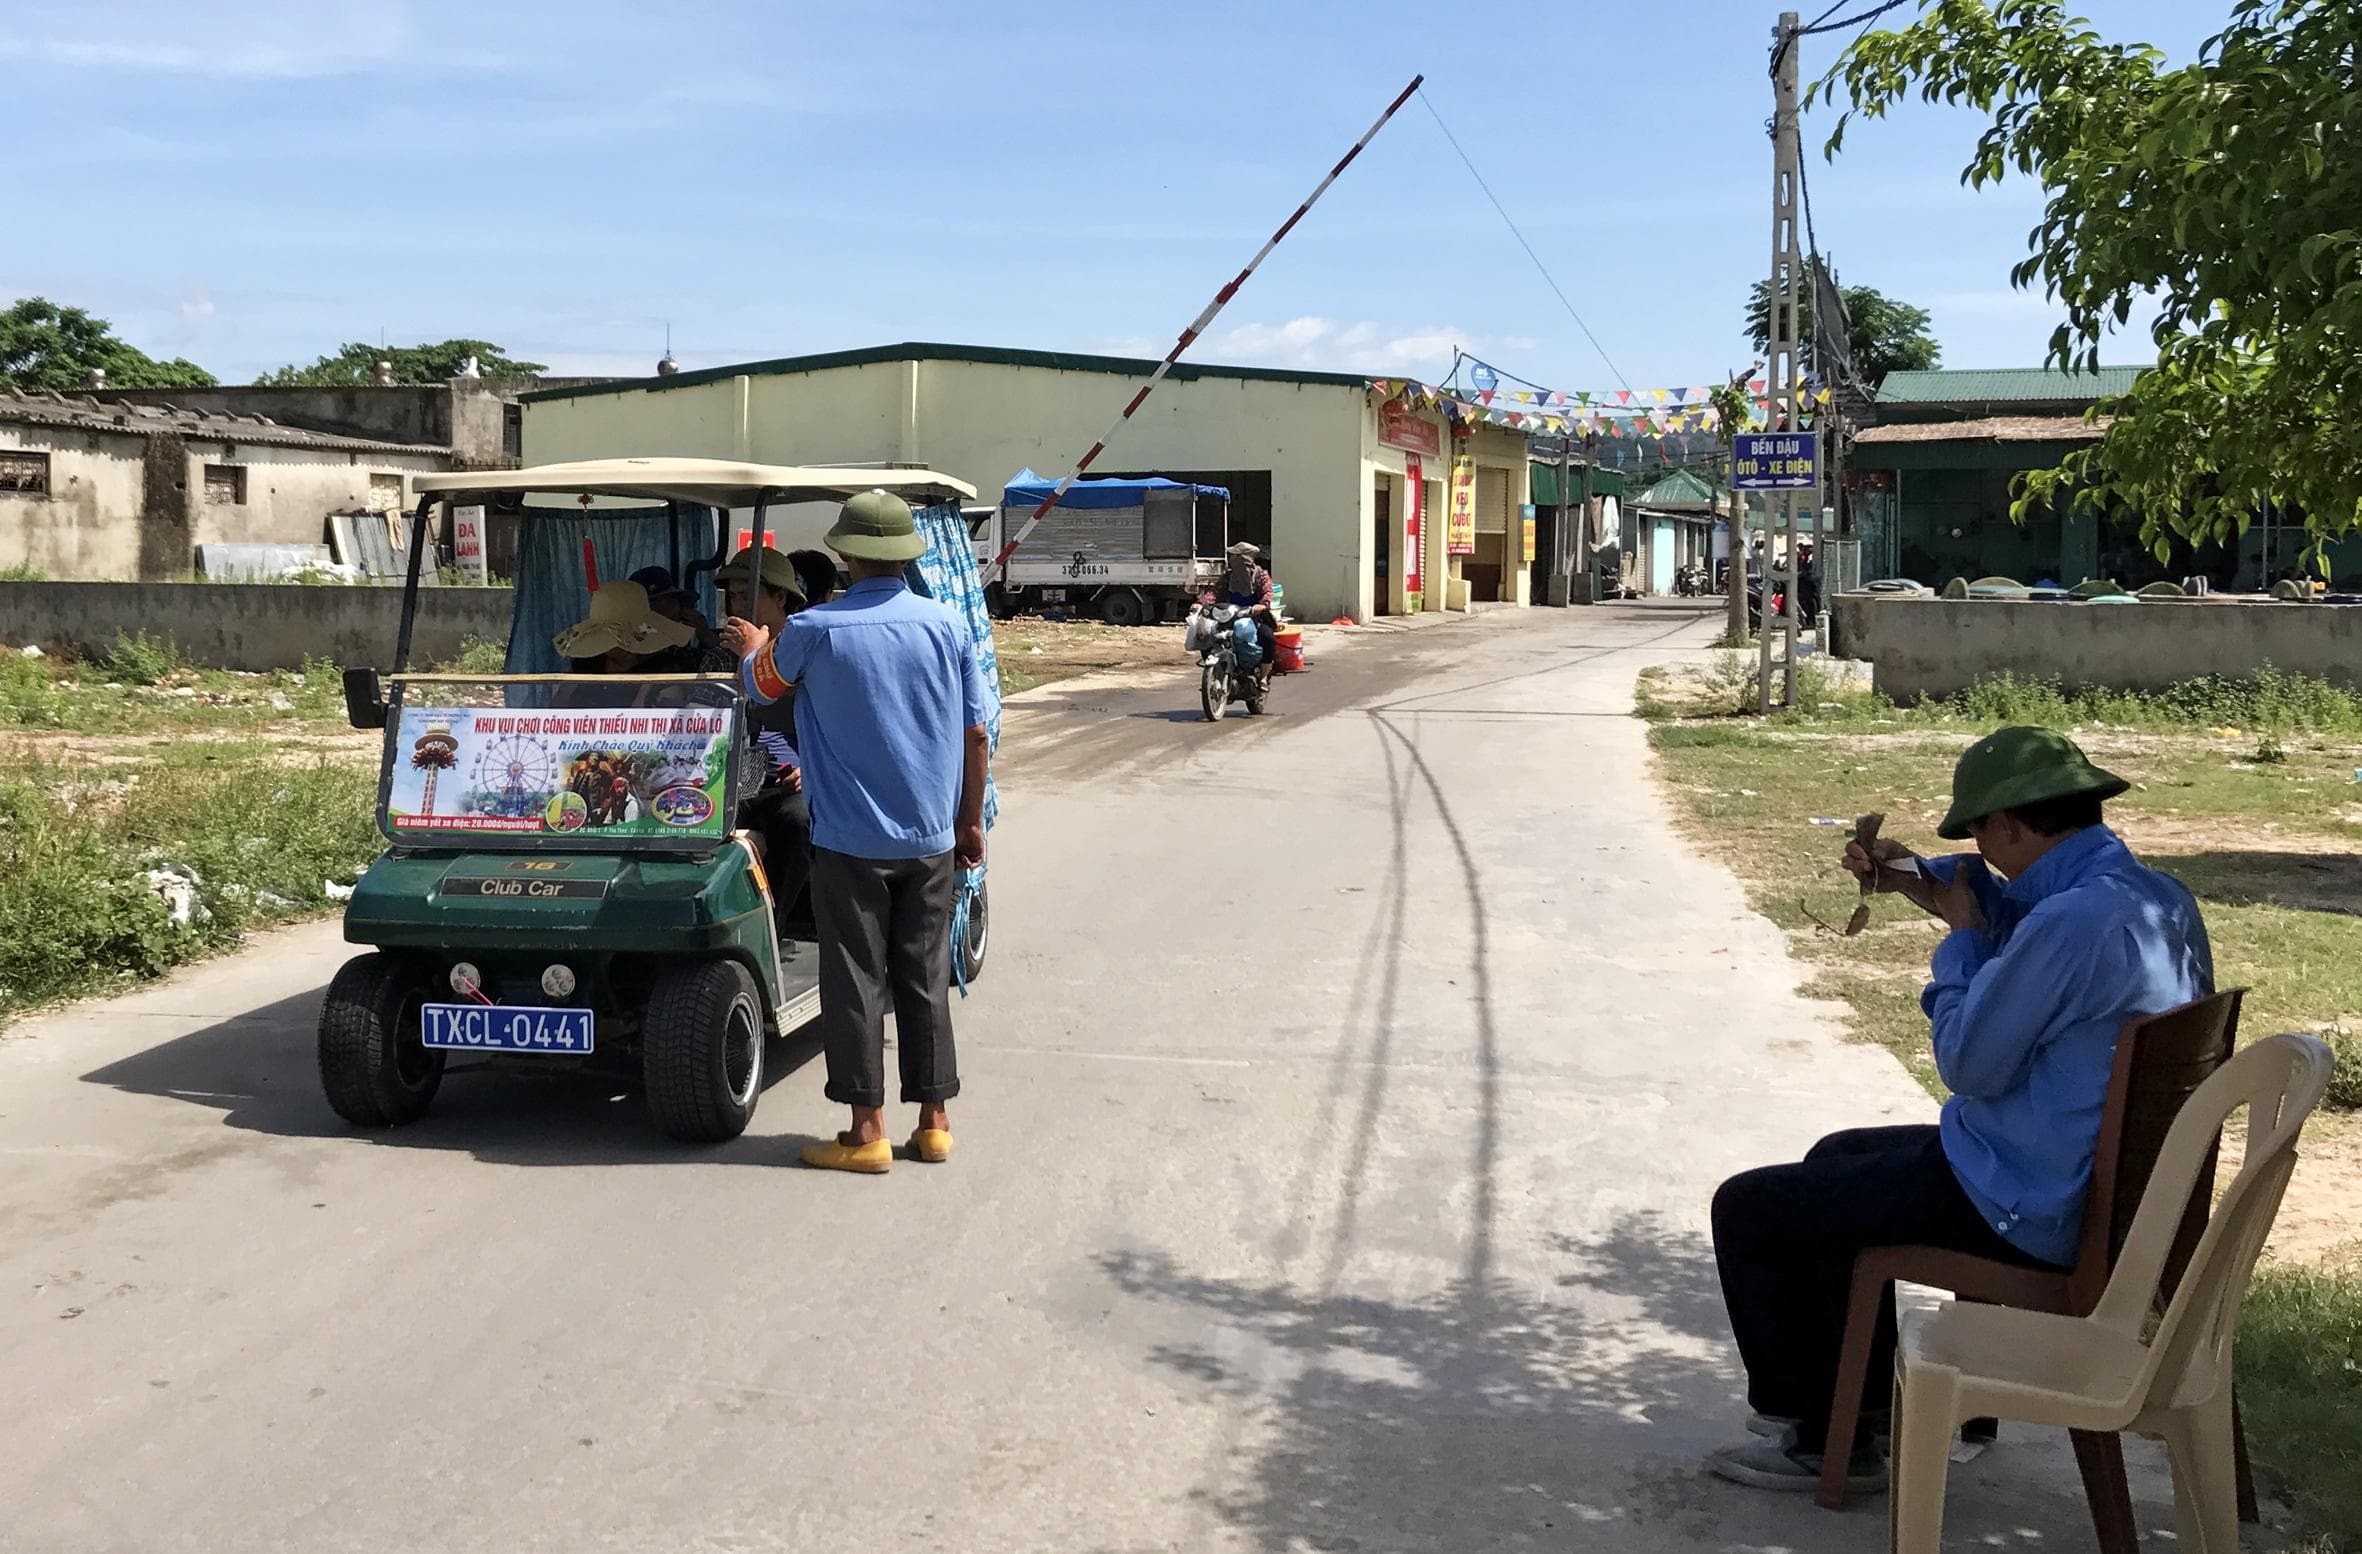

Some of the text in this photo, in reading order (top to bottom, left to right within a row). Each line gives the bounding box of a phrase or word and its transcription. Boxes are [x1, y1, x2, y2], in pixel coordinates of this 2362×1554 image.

[1751, 437, 1800, 457] BẾN ĐẬU
[1769, 460, 1783, 474] XE
[1786, 457, 1813, 477] ĐIỆN
[475, 717, 496, 734] KHU
[498, 717, 515, 734] VUI
[516, 716, 541, 734] CHƠI
[543, 714, 571, 734] CÔNG
[573, 714, 597, 734] VIÊN
[599, 713, 628, 734] THIẾU
[630, 718, 648, 734] NHI
[651, 718, 667, 737] THỊ
[669, 714, 685, 734] XÃ
[686, 713, 706, 734] CỬA
[480, 880, 564, 896] Club Car
